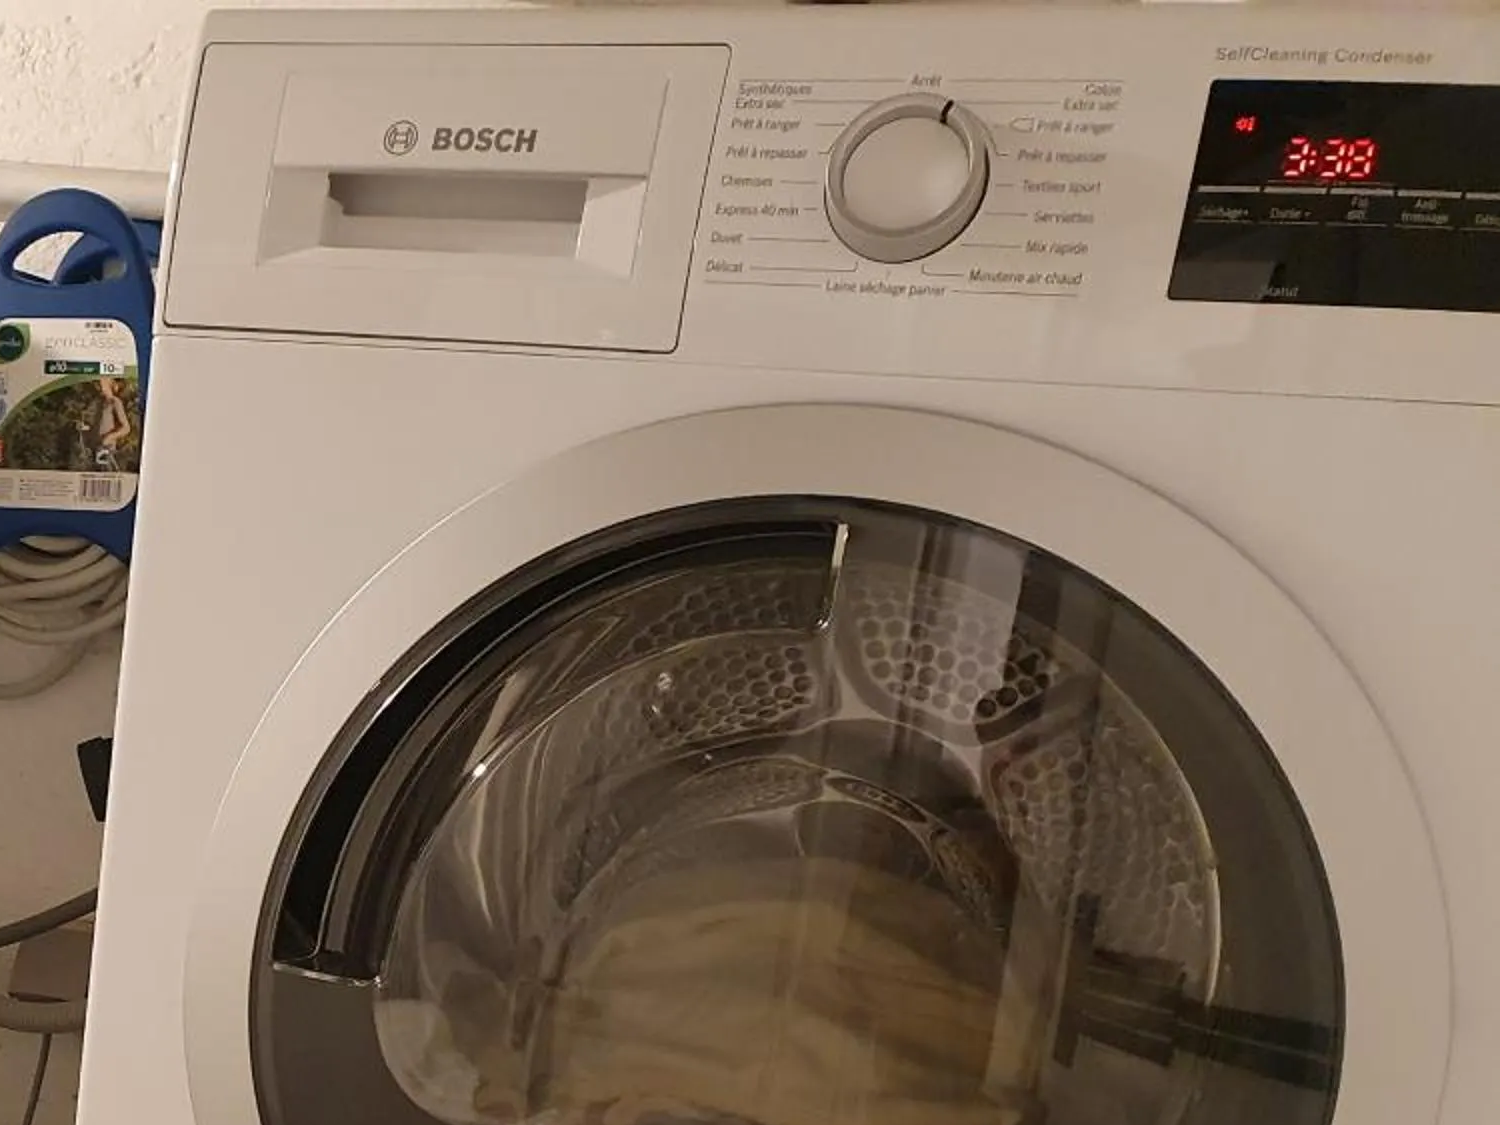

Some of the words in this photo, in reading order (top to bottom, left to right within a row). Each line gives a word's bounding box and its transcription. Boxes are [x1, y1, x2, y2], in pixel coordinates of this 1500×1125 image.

[1214, 46, 1329, 65] SelfCleaning
[1334, 48, 1435, 64] Condenser
[431, 127, 538, 153] BOSCH
[1282, 135, 1376, 178] 3:38
[721, 175, 773, 187] Chemises
[715, 204, 759, 216] Express
[777, 205, 799, 216] min
